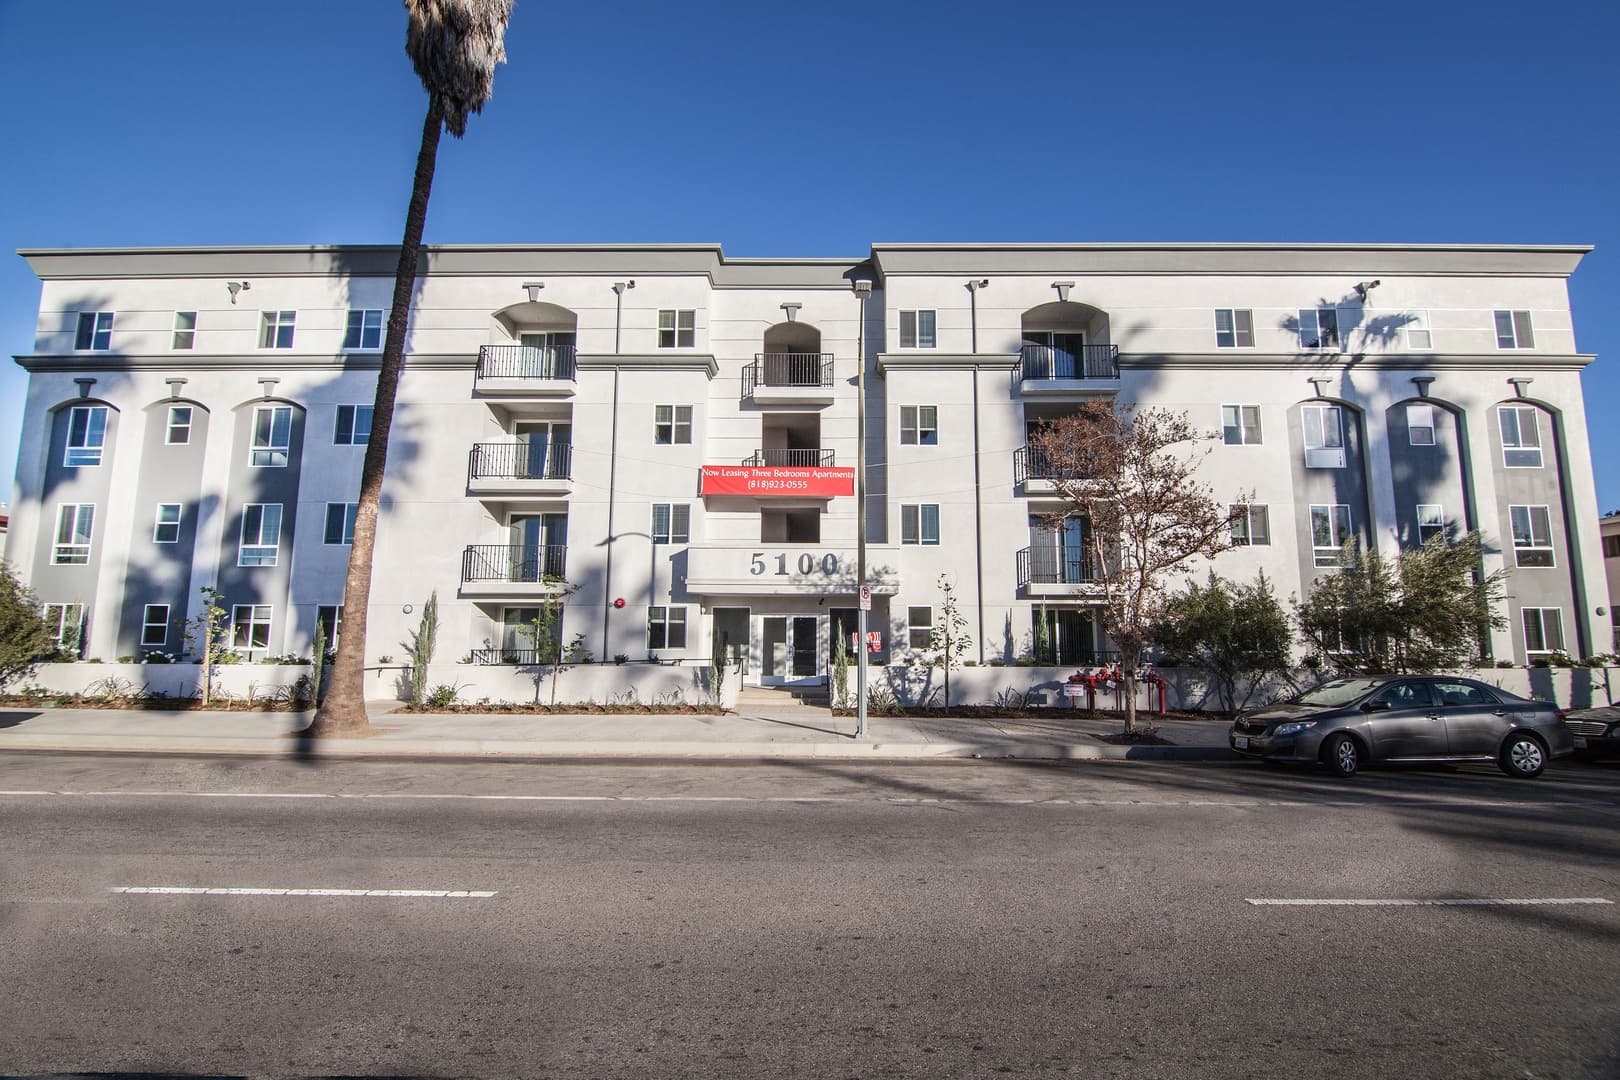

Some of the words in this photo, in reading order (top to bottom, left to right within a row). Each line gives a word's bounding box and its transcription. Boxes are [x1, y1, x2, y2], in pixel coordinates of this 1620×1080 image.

[702, 467, 719, 477] Now
[721, 468, 749, 479] Leasing
[752, 469, 771, 477] Three
[774, 469, 809, 478] Bedrooms
[747, 480, 808, 490] (818)923-0555
[750, 553, 838, 576] 5100
